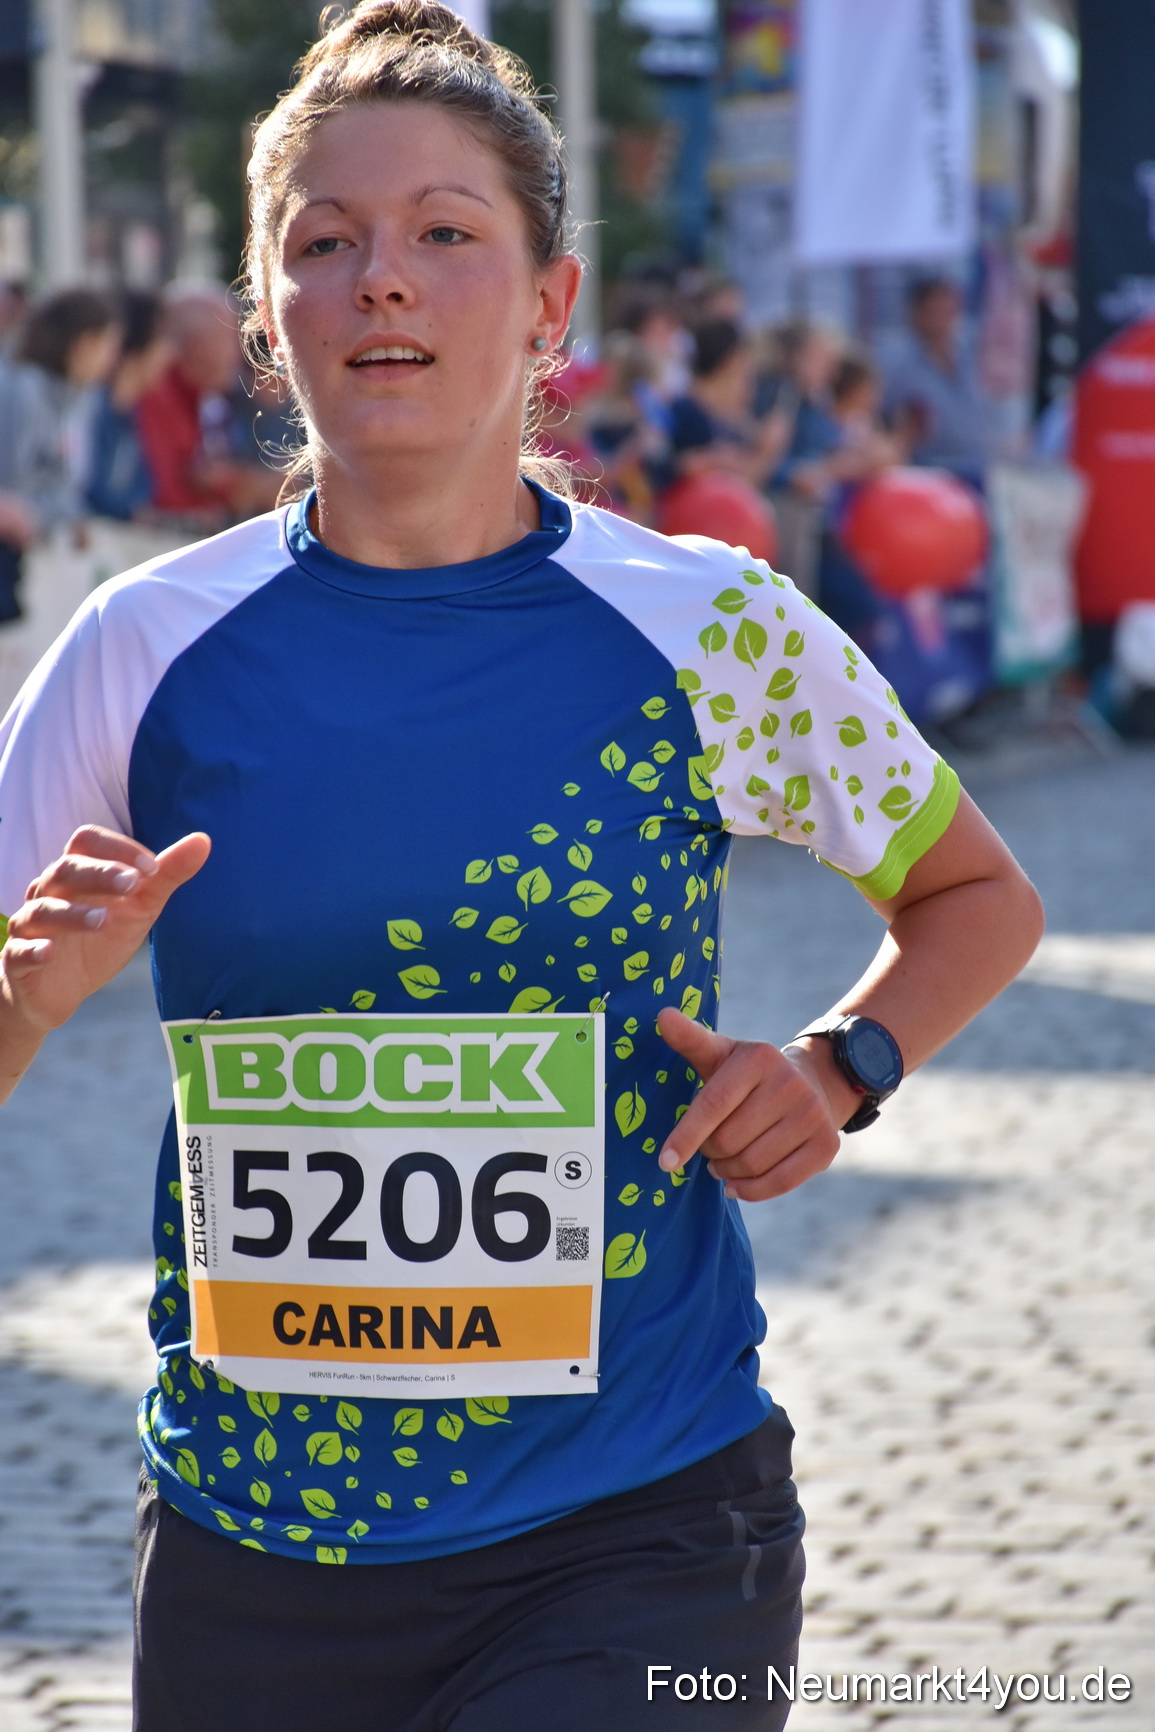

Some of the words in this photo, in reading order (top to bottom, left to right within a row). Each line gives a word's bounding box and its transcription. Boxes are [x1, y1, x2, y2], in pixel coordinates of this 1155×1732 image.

[211, 1042, 544, 1102] BOCK
[565, 1161, 582, 1180] S
[231, 1150, 552, 1263] 5206
[272, 1301, 502, 1350] CARINA
[309, 1371, 332, 1379] HERVIS
[376, 1374, 423, 1383] Schwarzfischer,
